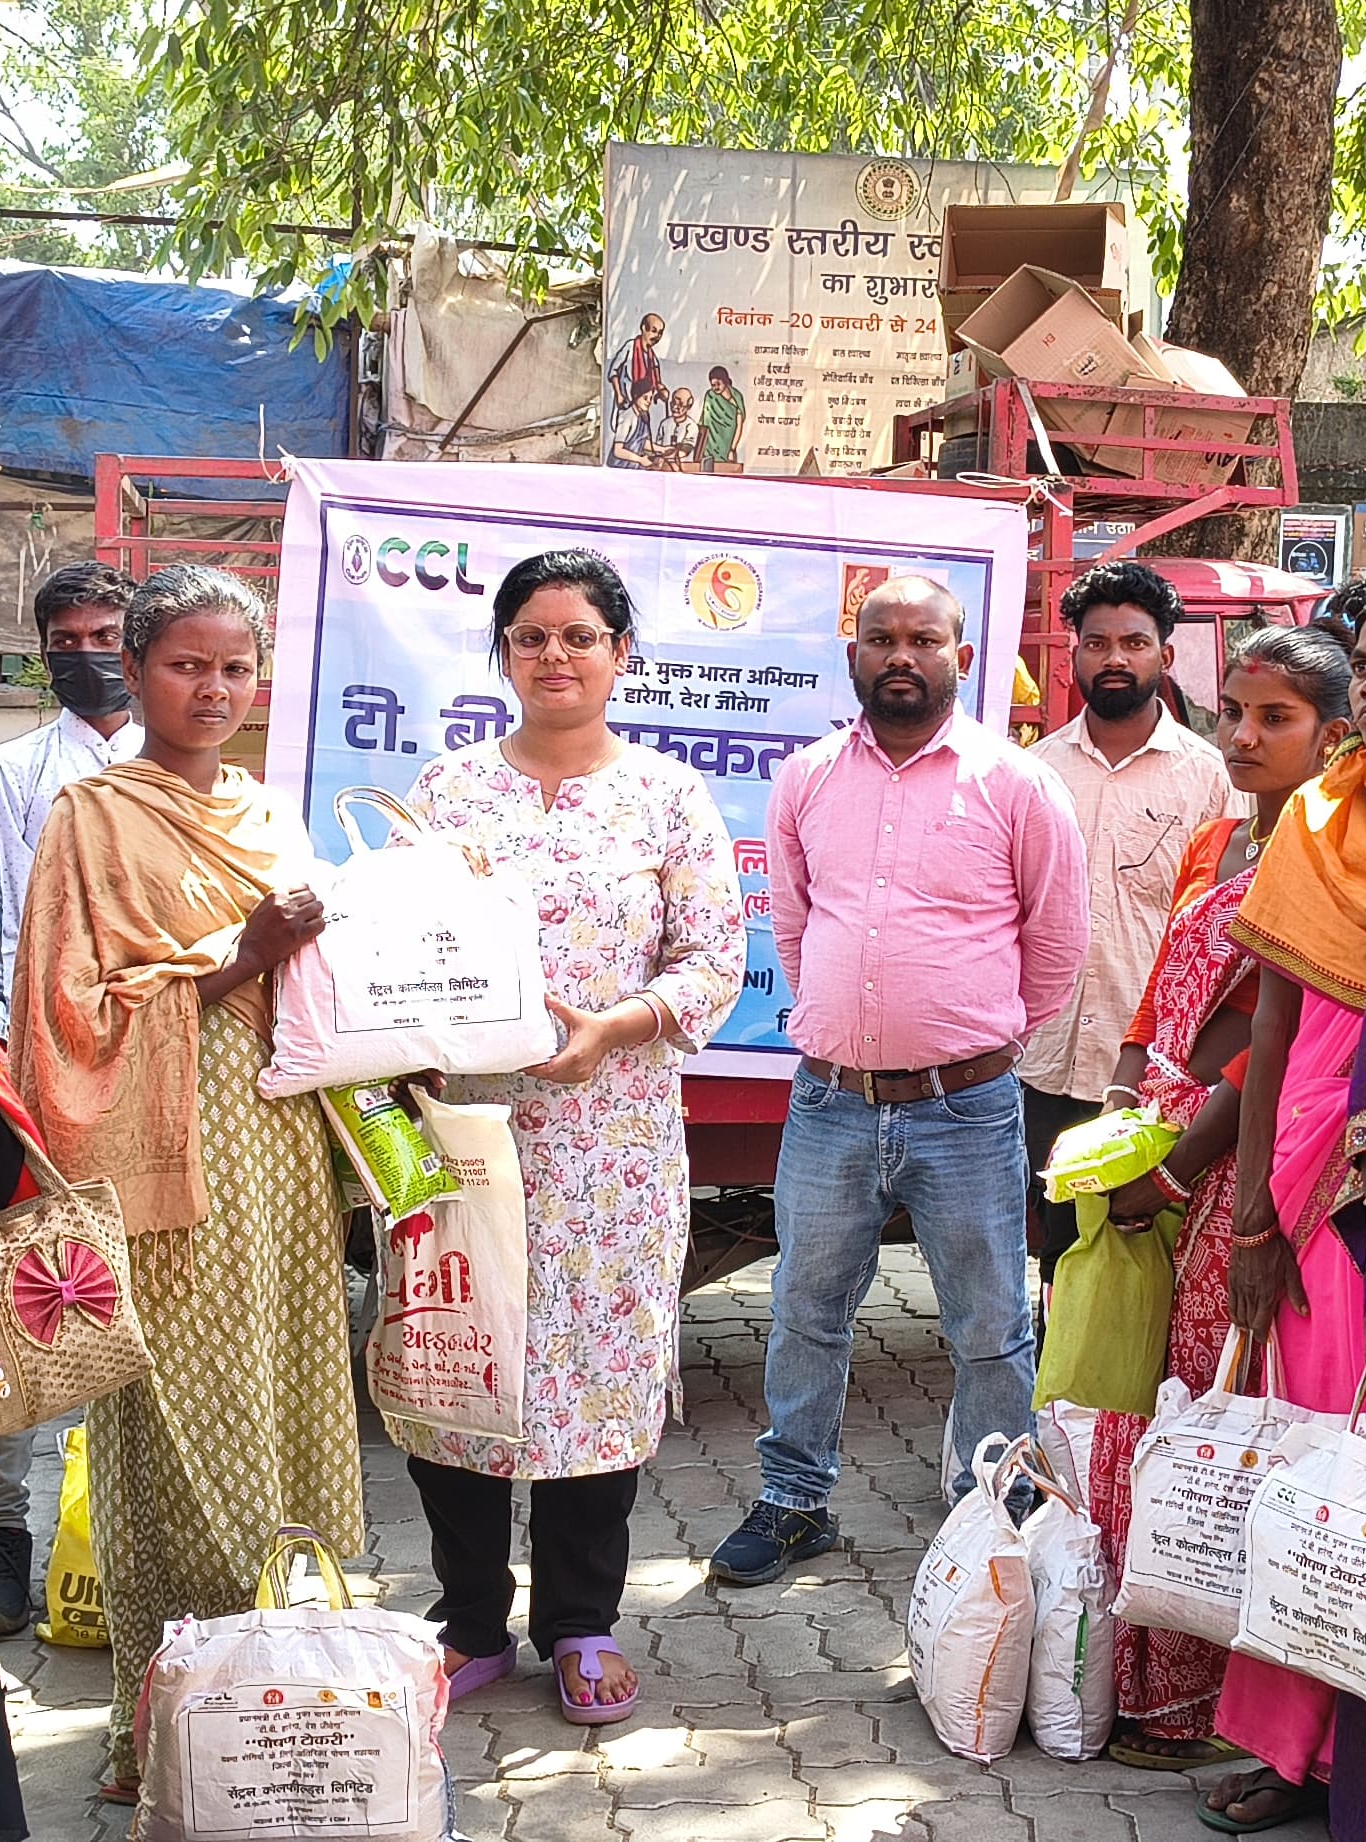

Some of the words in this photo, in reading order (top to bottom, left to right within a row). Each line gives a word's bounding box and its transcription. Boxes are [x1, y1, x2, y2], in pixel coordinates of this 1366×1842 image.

[666, 222, 774, 253] प्रखण्ड
[785, 219, 895, 258] स्तरीय
[820, 273, 855, 294] का
[717, 306, 774, 327] दिनांक
[819, 312, 883, 332] जनवरी
[889, 315, 908, 333] से
[914, 318, 937, 334] 24
[376, 536, 485, 596] CCL
[655, 661, 693, 684] मुक्त
[698, 666, 742, 684] भारत
[746, 666, 819, 689] अभियान
[624, 683, 674, 710] हारेगा,
[680, 686, 711, 709] देश
[715, 690, 770, 713] जीतेगा
[342, 684, 418, 754] टी.
[1291, 1607, 1348, 1639] कोलफील्ड्स
[262, 1779, 325, 1799] कोलफील्ड्स
[331, 1779, 374, 1794] लिमिटेड
